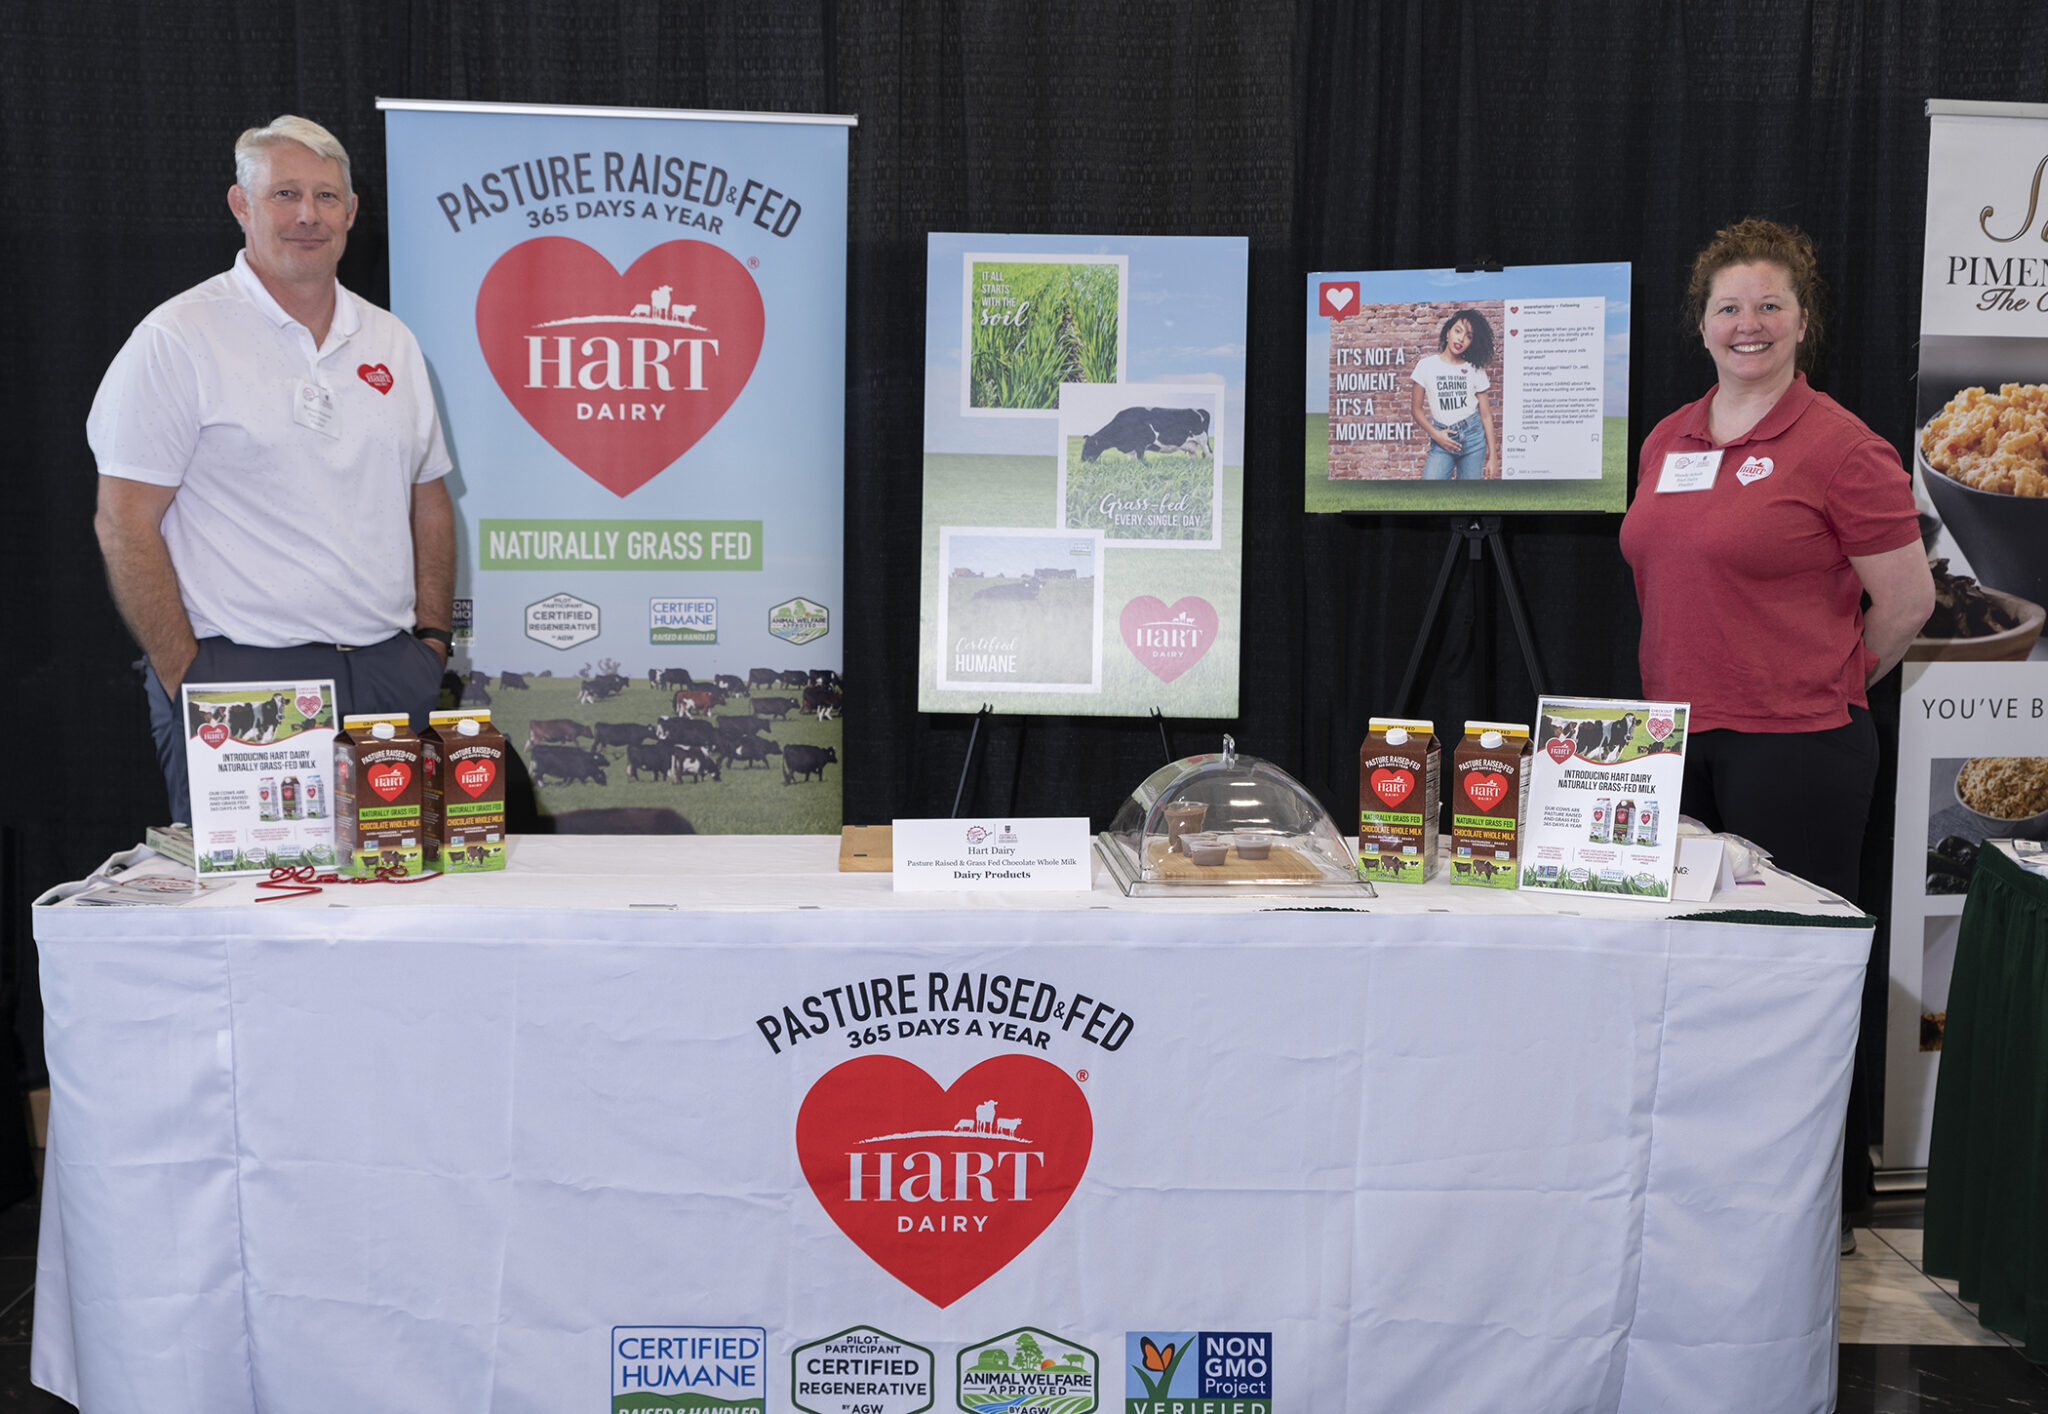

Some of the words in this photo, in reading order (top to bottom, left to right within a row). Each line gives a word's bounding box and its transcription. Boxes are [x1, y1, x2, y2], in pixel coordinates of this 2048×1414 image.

[437, 152, 594, 233] PASTURE
[605, 151, 728, 206] RAISED
[734, 179, 802, 238] FED
[527, 205, 569, 228] 365
[576, 200, 635, 219] DAYS
[642, 205, 658, 219] A
[664, 205, 723, 234] YEAR
[982, 272, 989, 281] IT
[991, 272, 1004, 281] ALL
[1947, 256, 2048, 286] PIME
[982, 284, 1009, 294] STARTS
[982, 297, 1000, 306] WITH
[1002, 298, 1016, 307] THE
[1976, 288, 2030, 312] The
[1337, 348, 1362, 366] IT'S
[1365, 348, 1392, 365] NOT
[1395, 347, 1405, 365] A
[1437, 382, 1467, 390] CARING
[1336, 399, 1361, 416] IT'S
[1365, 398, 1374, 415] A
[1440, 397, 1467, 410] MILK
[577, 403, 665, 420] DAIRY
[1336, 422, 1413, 441] MOVEMENT
[1100, 493, 1189, 518] Grass-fed
[490, 531, 619, 560] NATURALLY
[628, 531, 702, 560] GRASS
[711, 532, 751, 560] FED
[653, 603, 714, 612] CERTIFIED
[533, 611, 593, 620] CERTIFIED
[654, 615, 712, 625] HUMANE
[955, 655, 1016, 673] HUMANE
[222, 752, 268, 762] INTRODUCING
[270, 751, 288, 759] HART
[290, 751, 310, 759] DAIRY
[218, 763, 258, 772] NATURALLY
[260, 761, 297, 770] GRASS-FED
[299, 760, 316, 769] MILK
[1365, 756, 1388, 768] PASTURE
[1410, 761, 1421, 771] FED
[1459, 760, 1482, 771] PASTURE
[1503, 765, 1514, 774] FED
[1564, 770, 1609, 780] INTRODUCING
[1610, 772, 1629, 781] HART
[1631, 774, 1652, 783] DAIRY
[1558, 779, 1598, 790] NATURALLY
[1599, 782, 1637, 792] GRASS-FED
[1638, 785, 1656, 794] MILK
[476, 804, 492, 812] GRASS
[360, 821, 389, 830] CHOCOLATE
[390, 820, 406, 828] WHOLE
[407, 819, 420, 827] MILK
[447, 817, 474, 826] CHOCOLATE
[475, 816, 491, 824] WHOLE
[492, 815, 504, 823] MILK
[1456, 817, 1484, 825] NATURALLY
[1485, 819, 1502, 827] GRASS
[1503, 820, 1513, 828] FED
[1361, 825, 1390, 834] CHOCOLATE
[1391, 827, 1408, 835] WHOLE
[1454, 829, 1482, 838] CHOCOLATE
[1483, 830, 1501, 839] WHOLE
[1502, 832, 1515, 840] MILK
[968, 846, 988, 855] Hart
[991, 846, 1015, 856] Dairy
[954, 870, 982, 880] Dairy
[985, 870, 1031, 879] Products
[756, 974, 918, 1054] PASTURE
[928, 972, 1057, 1023] RAISED
[1062, 994, 1134, 1052] FED
[847, 1023, 891, 1048] 365
[899, 1018, 959, 1039] DAYS
[965, 1019, 982, 1036] A
[988, 1021, 1051, 1050] YEAR
[898, 1216, 988, 1232] DAIRY
[846, 1336, 879, 1345] PILOT
[1207, 1338, 1265, 1356] NON
[618, 1338, 759, 1360] CERTIFIED
[825, 1345, 901, 1354] PARTICIPANT
[807, 1359, 919, 1376] CERTIFIED
[1205, 1358, 1267, 1377] GMO
[622, 1365, 755, 1387] HUMANE
[963, 1372, 1019, 1385] ANIMAL
[1022, 1374, 1092, 1387] WELFARE
[800, 1383, 927, 1395] REGENERATIVE
[988, 1386, 1067, 1395] APPROVED
[1205, 1379, 1266, 1398] Project
[852, 1404, 884, 1414] AGW
